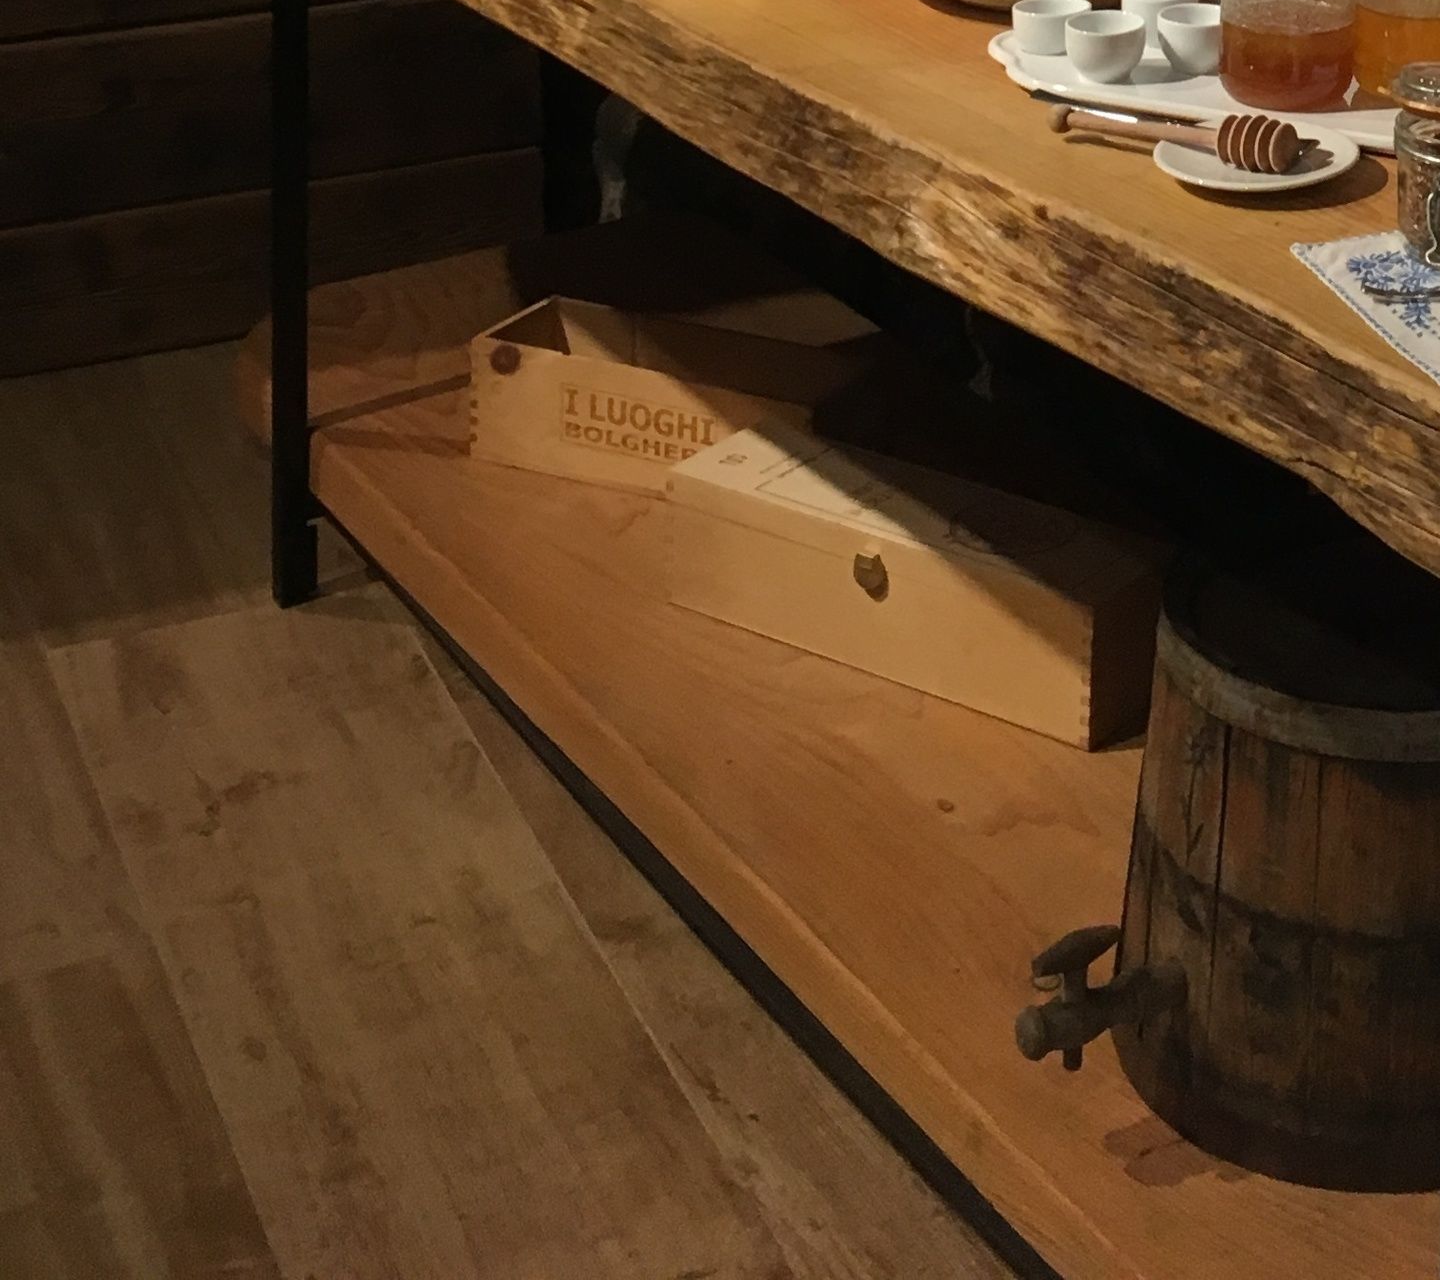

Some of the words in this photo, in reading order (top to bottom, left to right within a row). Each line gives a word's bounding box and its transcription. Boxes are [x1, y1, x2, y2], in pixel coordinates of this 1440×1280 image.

[565, 388, 579, 417] I
[590, 393, 715, 446] LUOGHI
[565, 421, 698, 460] BOLGHER
